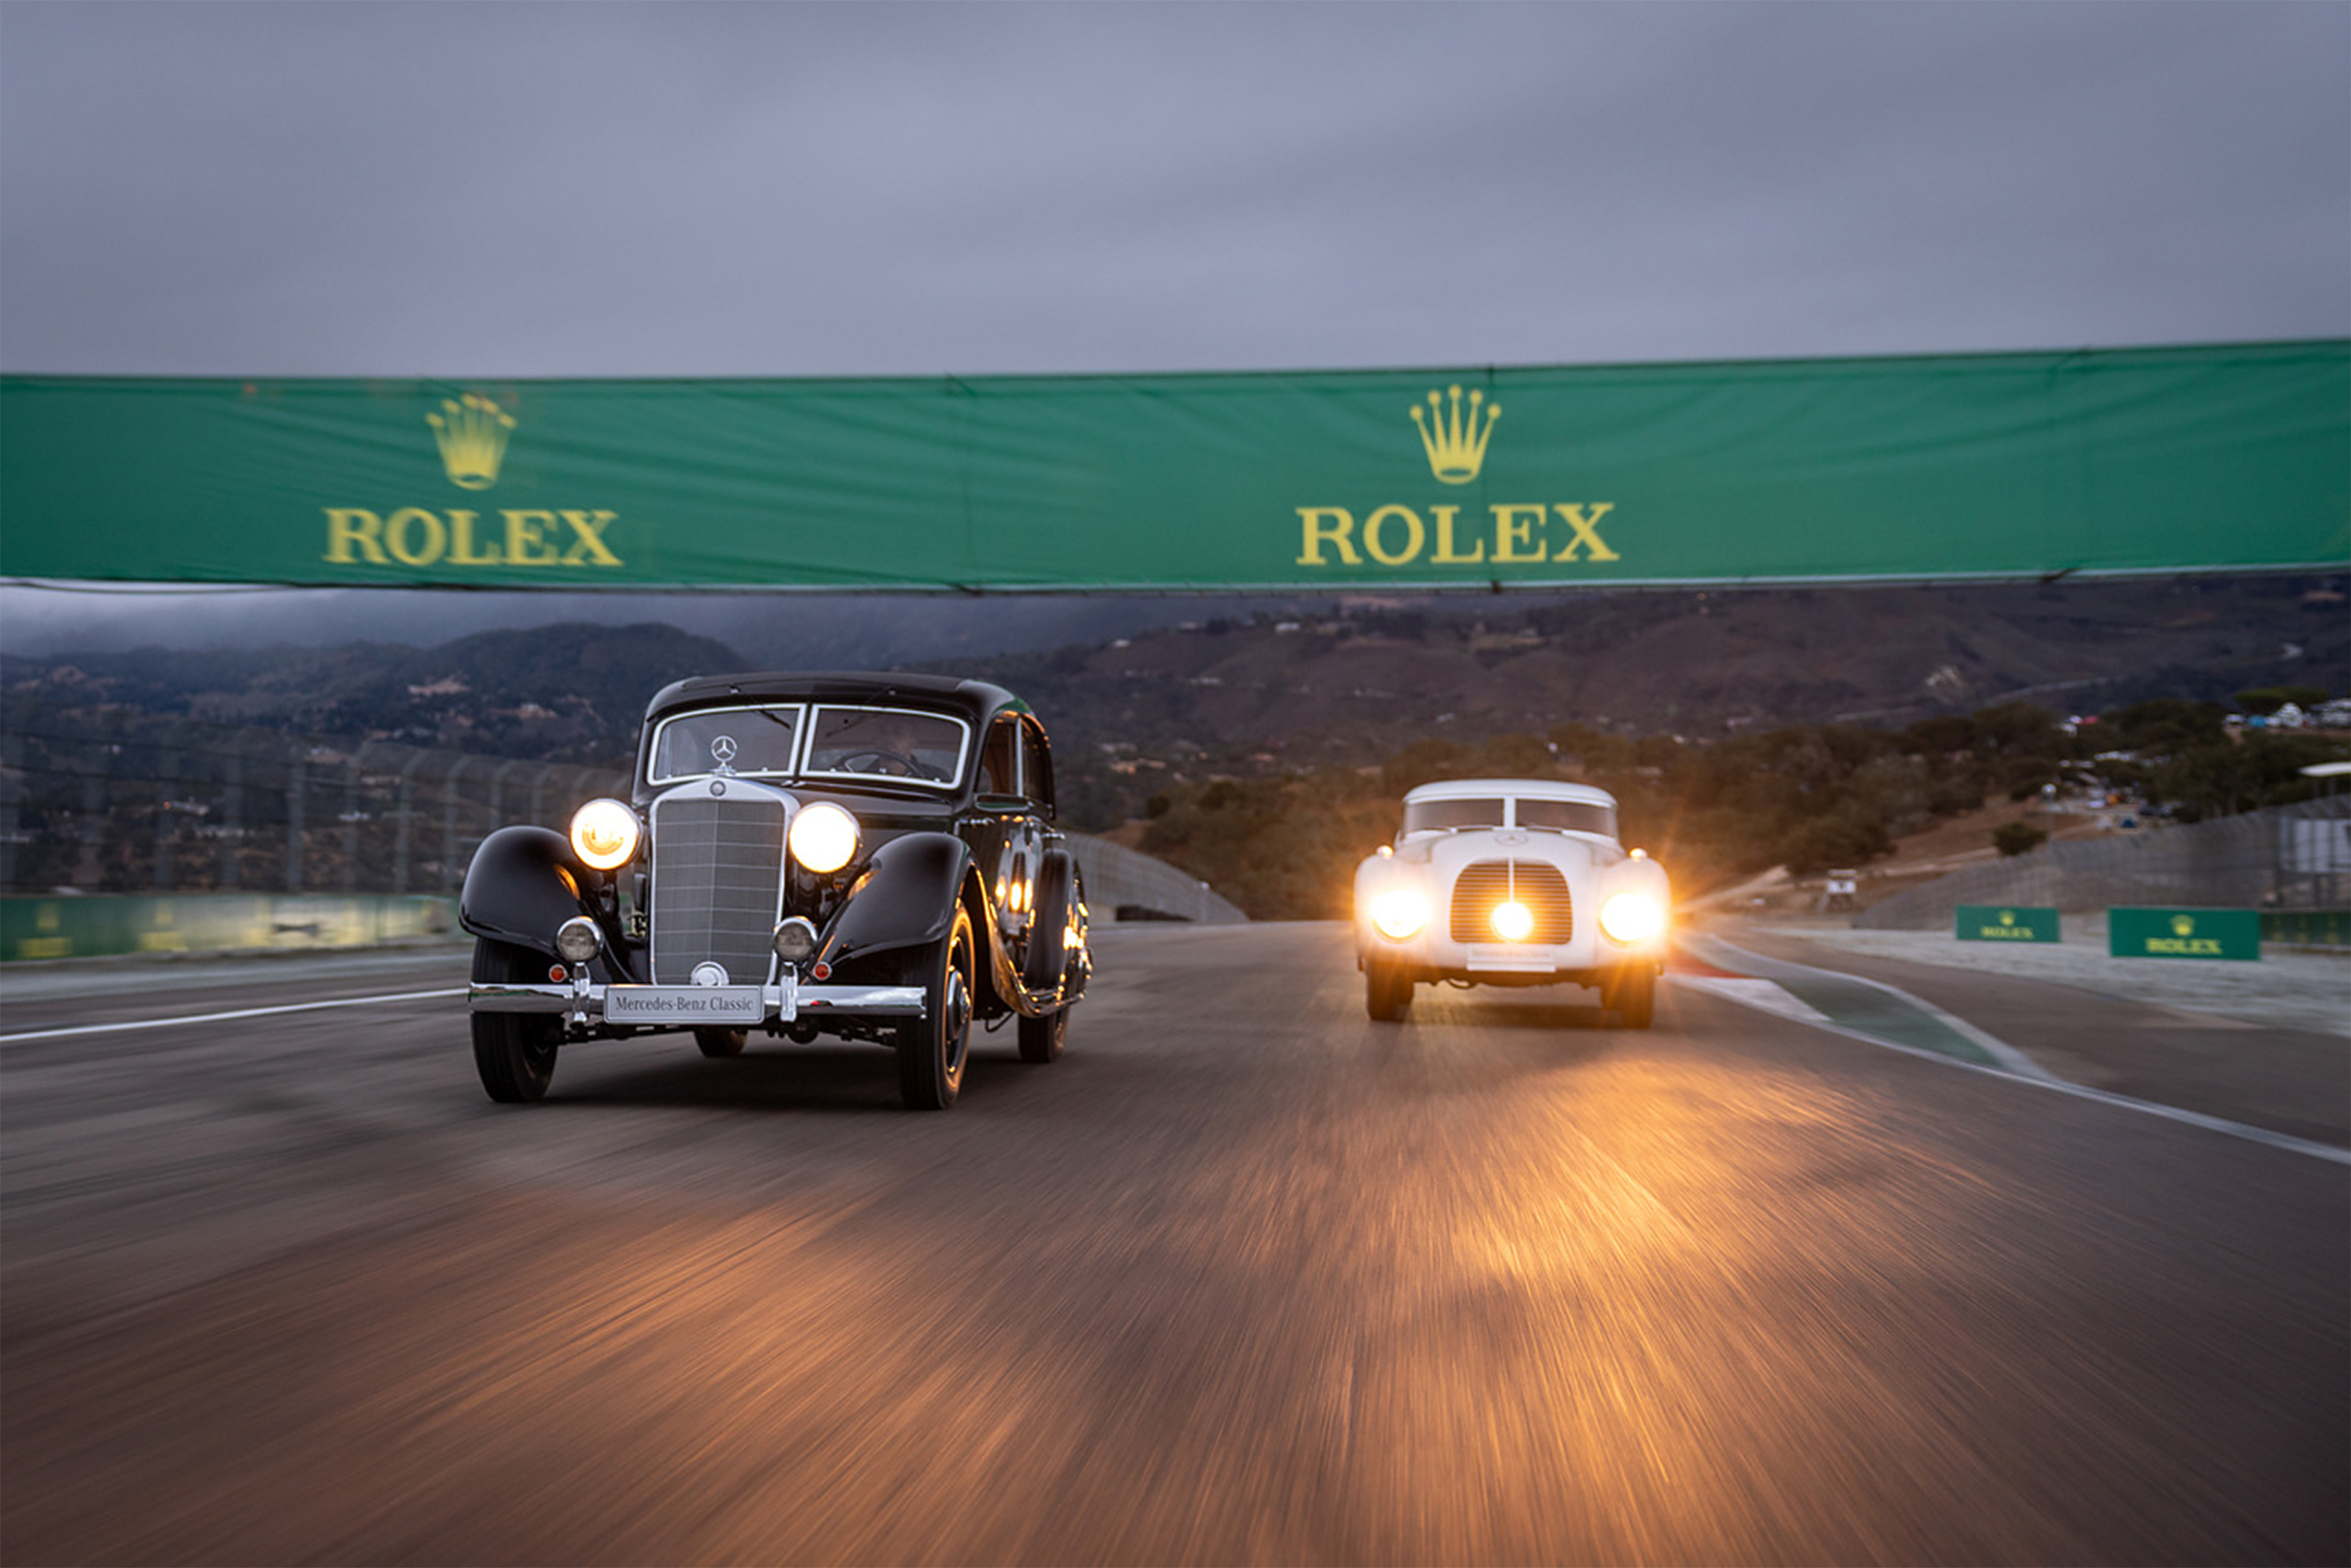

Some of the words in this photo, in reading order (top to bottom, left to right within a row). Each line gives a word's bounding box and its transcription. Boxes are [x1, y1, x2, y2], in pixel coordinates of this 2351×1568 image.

[323, 507, 624, 566] ROLEX
[1296, 503, 1620, 565] ROLEX
[615, 996, 706, 1011] Mercedes-Benz
[710, 997, 753, 1011] Classic
